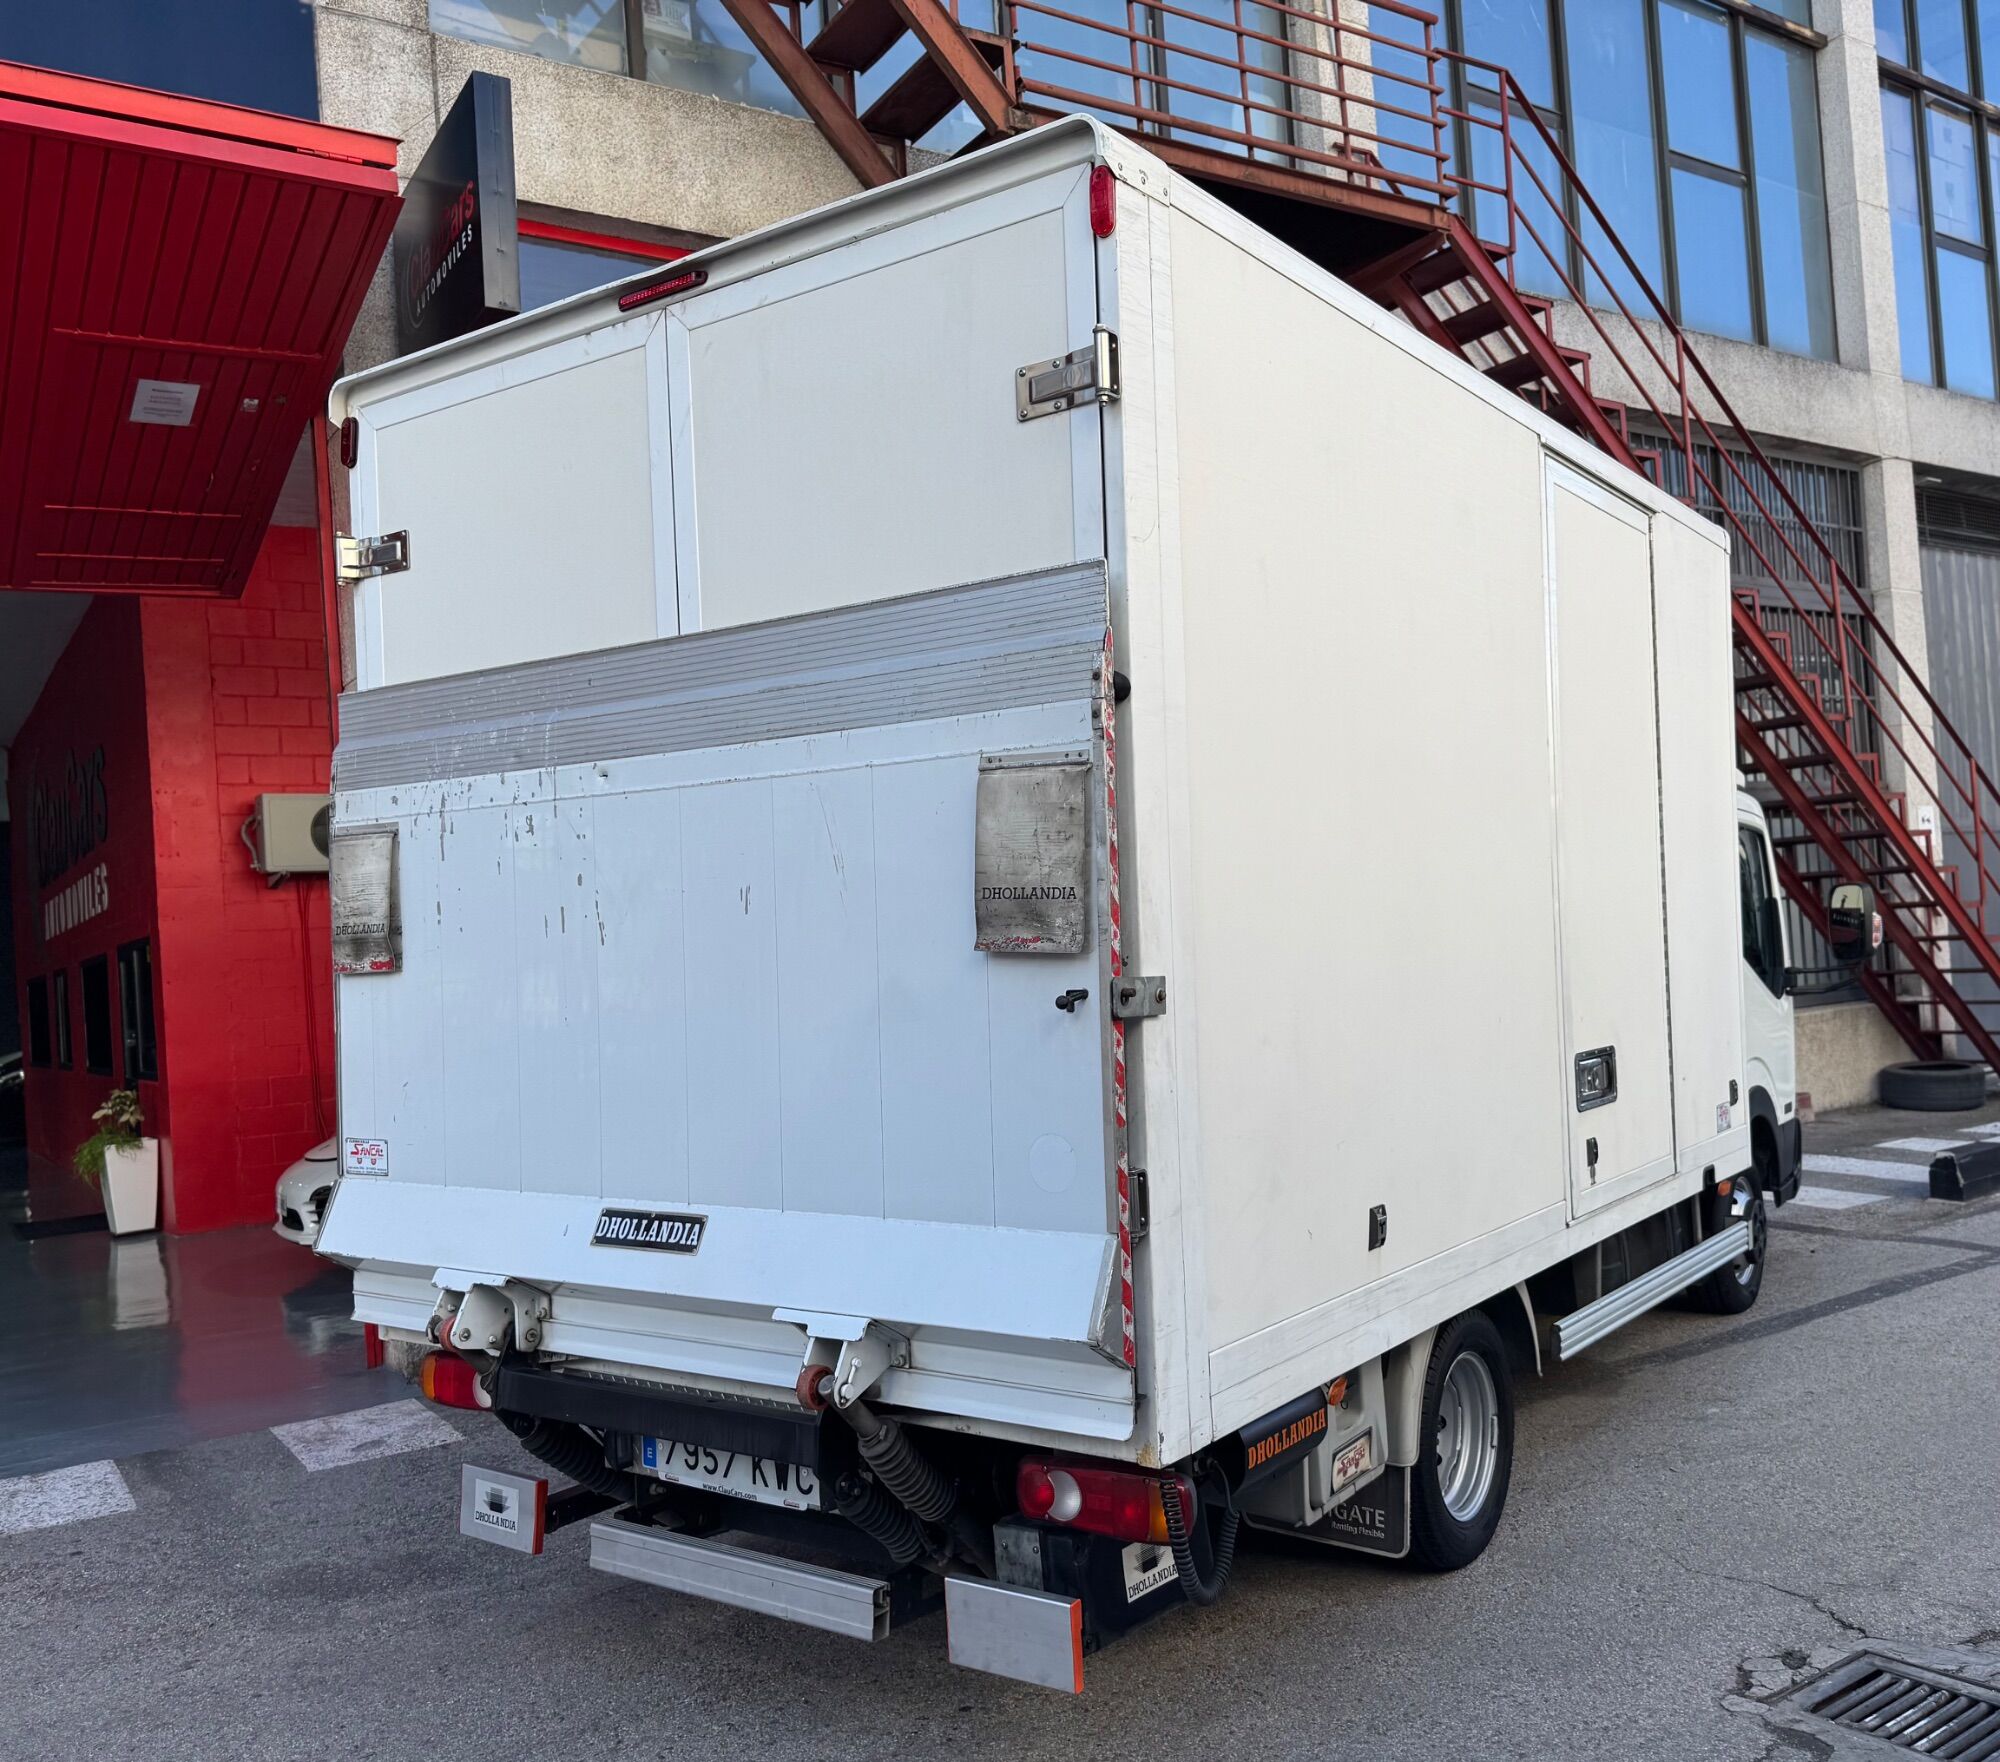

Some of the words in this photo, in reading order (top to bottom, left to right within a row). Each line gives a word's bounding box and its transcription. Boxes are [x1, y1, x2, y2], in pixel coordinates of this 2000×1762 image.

[416, 223, 473, 317] AUTOMOVILES
[982, 886, 1077, 900] DHOLLANDIA
[335, 923, 385, 936] DHOLLANDIA
[595, 1215, 701, 1246] DHOLLANDIA
[1247, 1407, 1327, 1470] DHOLLANDIA
[702, 1482, 758, 1501] www.ClauCars.com
[475, 1510, 517, 1532] DHOLLANDIA
[1128, 1563, 1178, 1599] DHOLLANDIA
